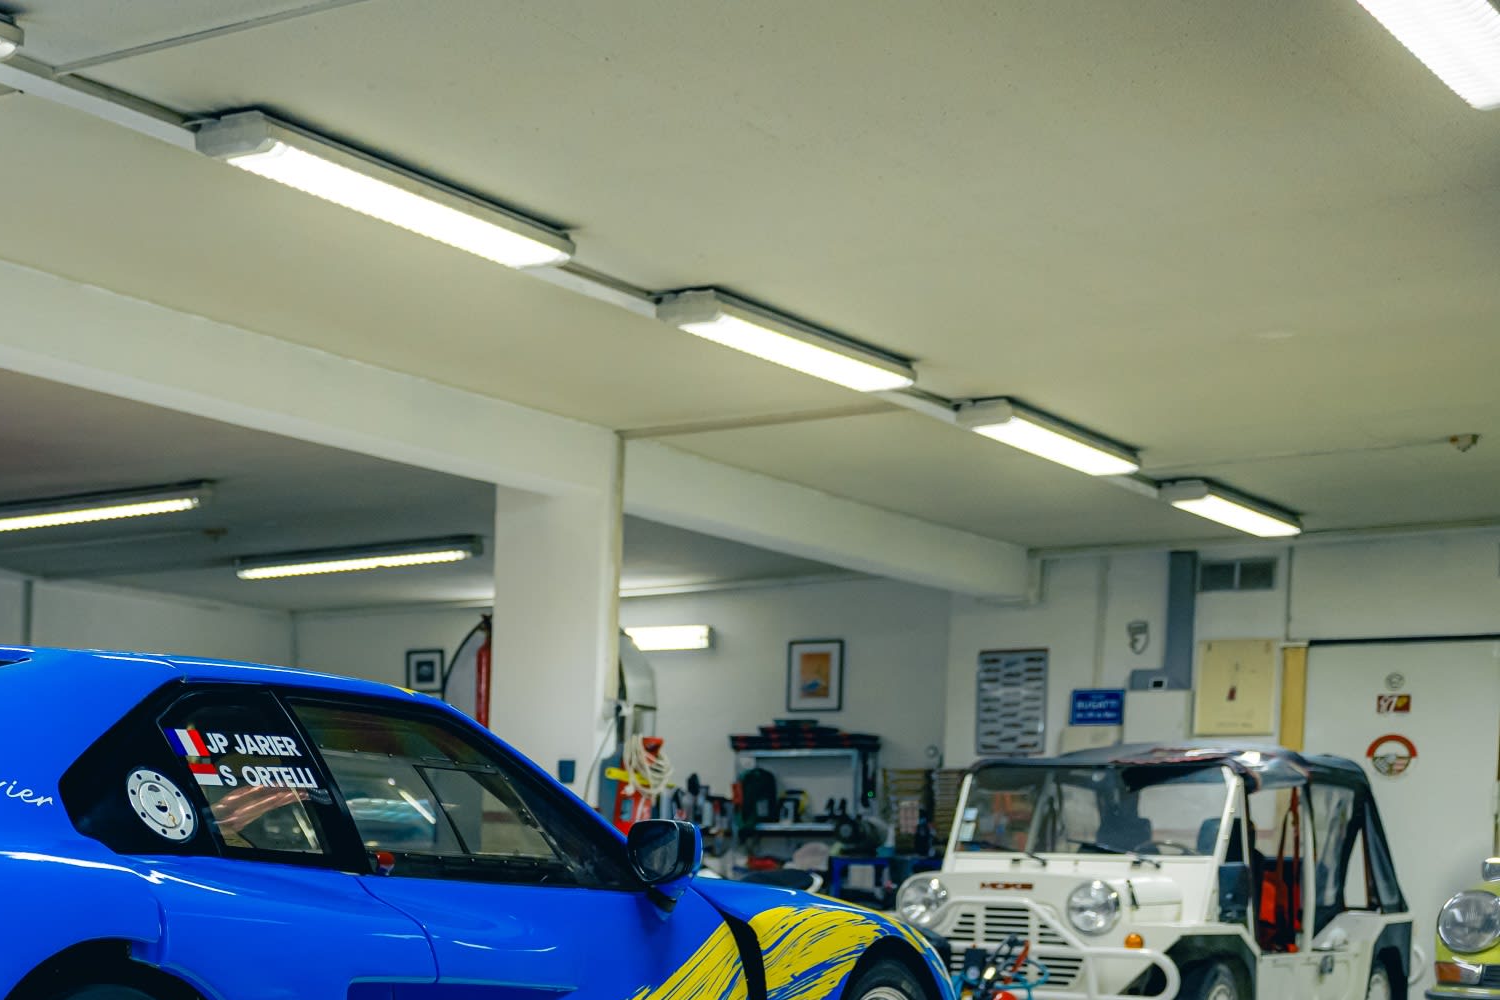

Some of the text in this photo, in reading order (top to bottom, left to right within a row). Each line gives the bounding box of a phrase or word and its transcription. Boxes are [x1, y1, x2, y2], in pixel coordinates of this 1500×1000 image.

[206, 732, 303, 757] JP JARIER
[218, 764, 319, 788] S ORTELLI
